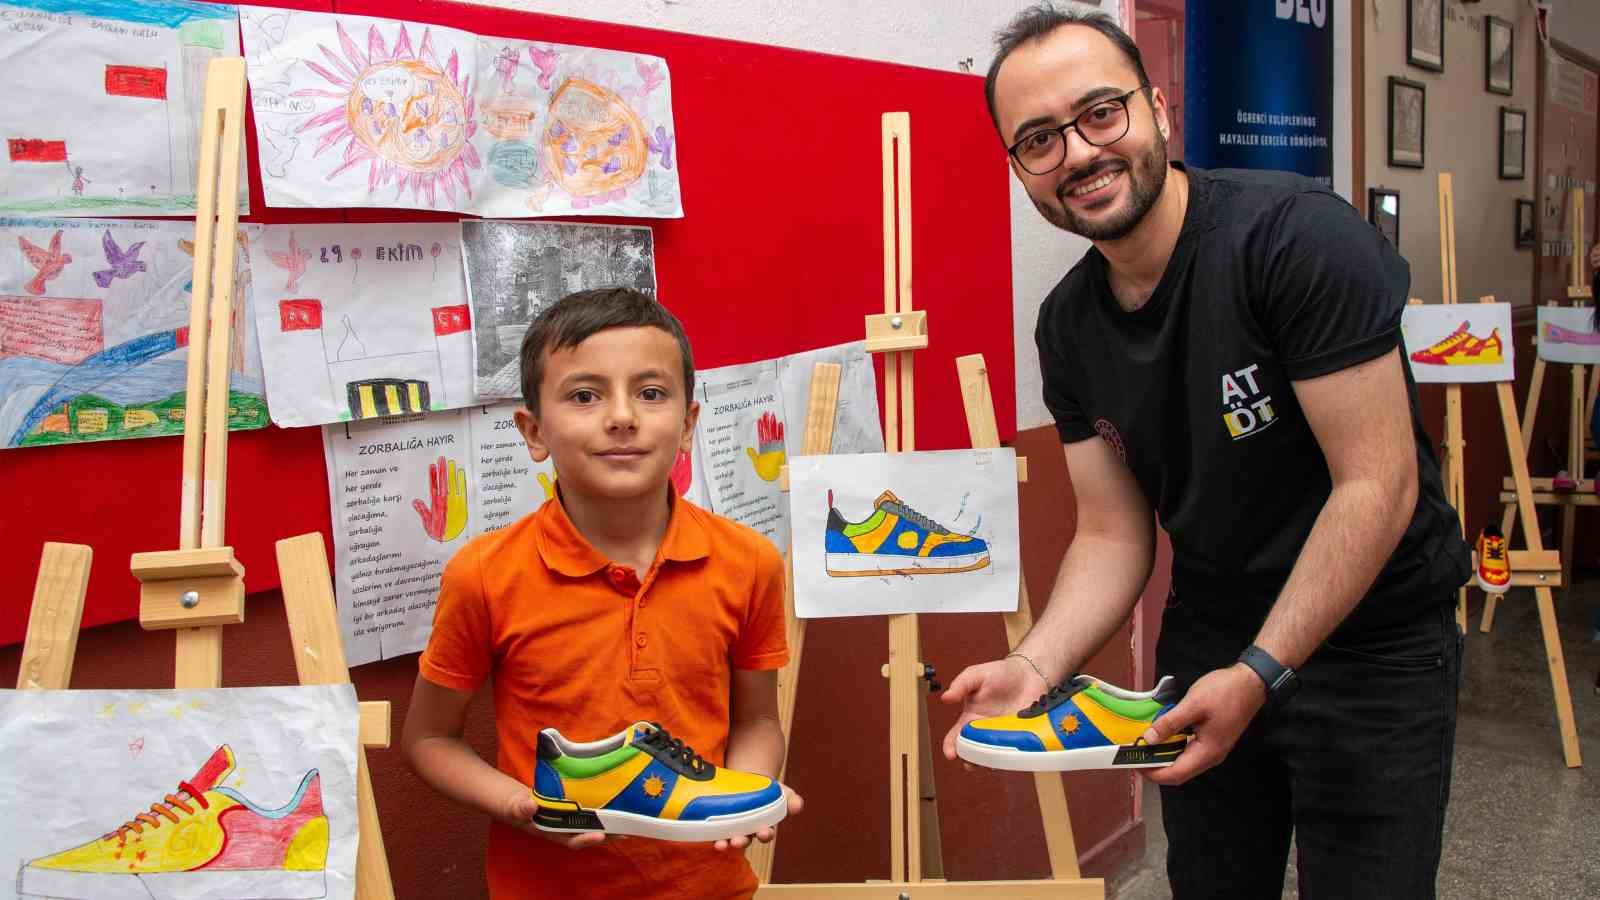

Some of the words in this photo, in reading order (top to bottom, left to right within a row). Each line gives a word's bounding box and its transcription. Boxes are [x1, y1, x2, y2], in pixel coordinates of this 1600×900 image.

[1219, 133, 1259, 145] HAYALLER
[320, 244, 343, 263] 29
[359, 436, 424, 456] ZORBALIĞA
[426, 433, 455, 447] HAYIR
[360, 481, 382, 492] yerde
